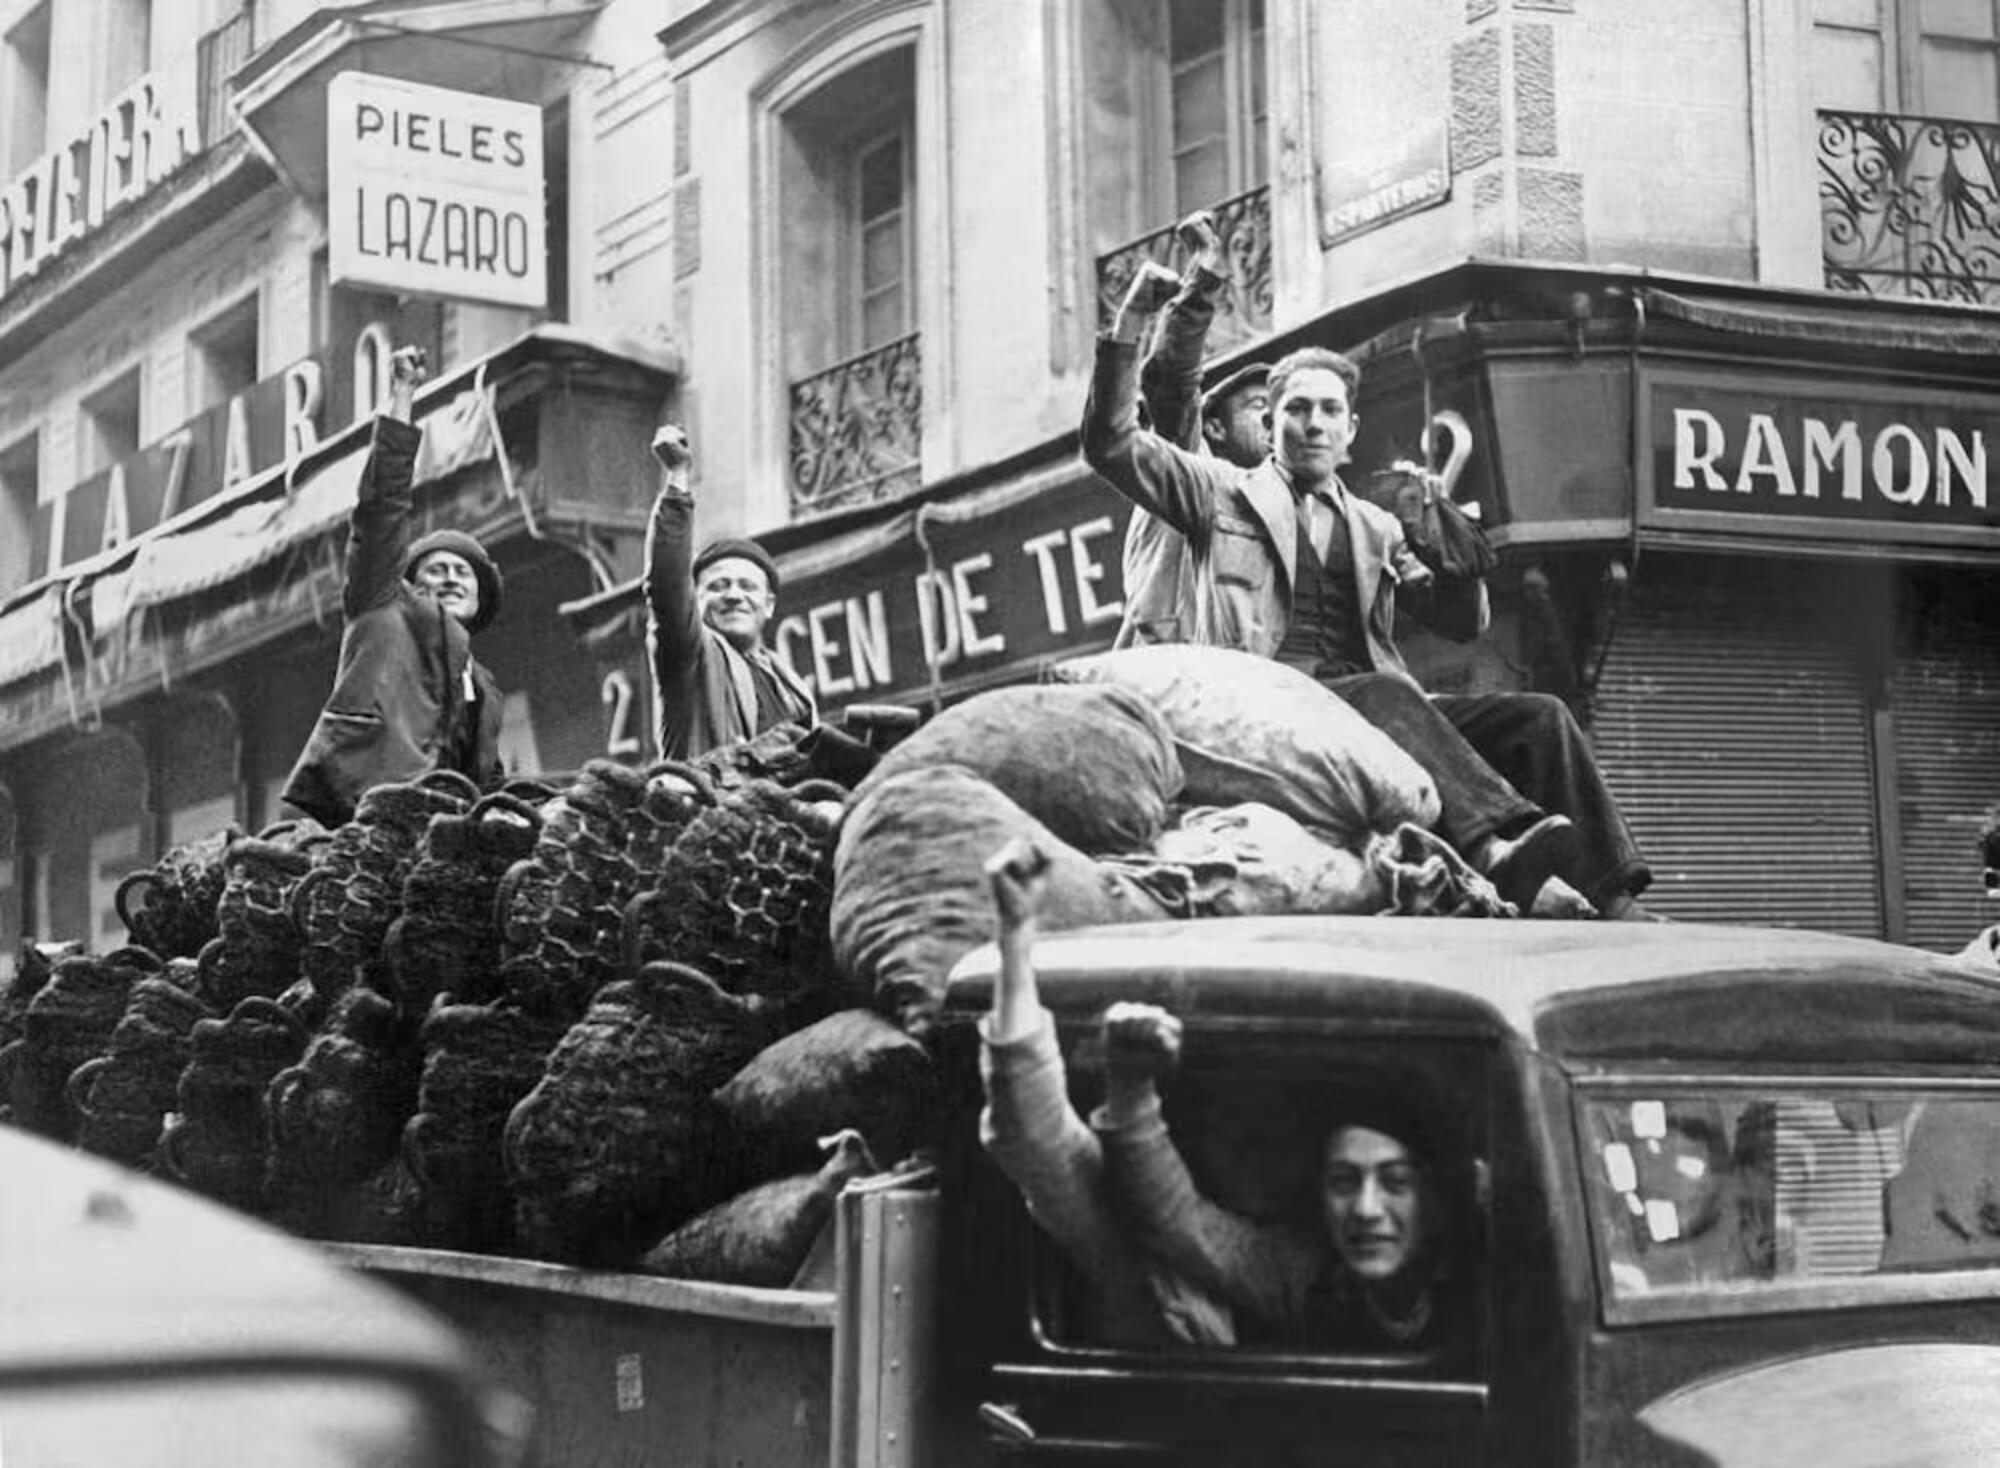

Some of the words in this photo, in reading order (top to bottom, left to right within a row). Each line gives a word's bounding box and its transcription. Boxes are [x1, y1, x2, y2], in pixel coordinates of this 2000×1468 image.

[356, 103, 525, 167] PIELES
[358, 186, 528, 279] LAZARO
[1674, 408, 1987, 508] RAMON
[915, 553, 1004, 668] DE
[602, 670, 640, 754] 2
